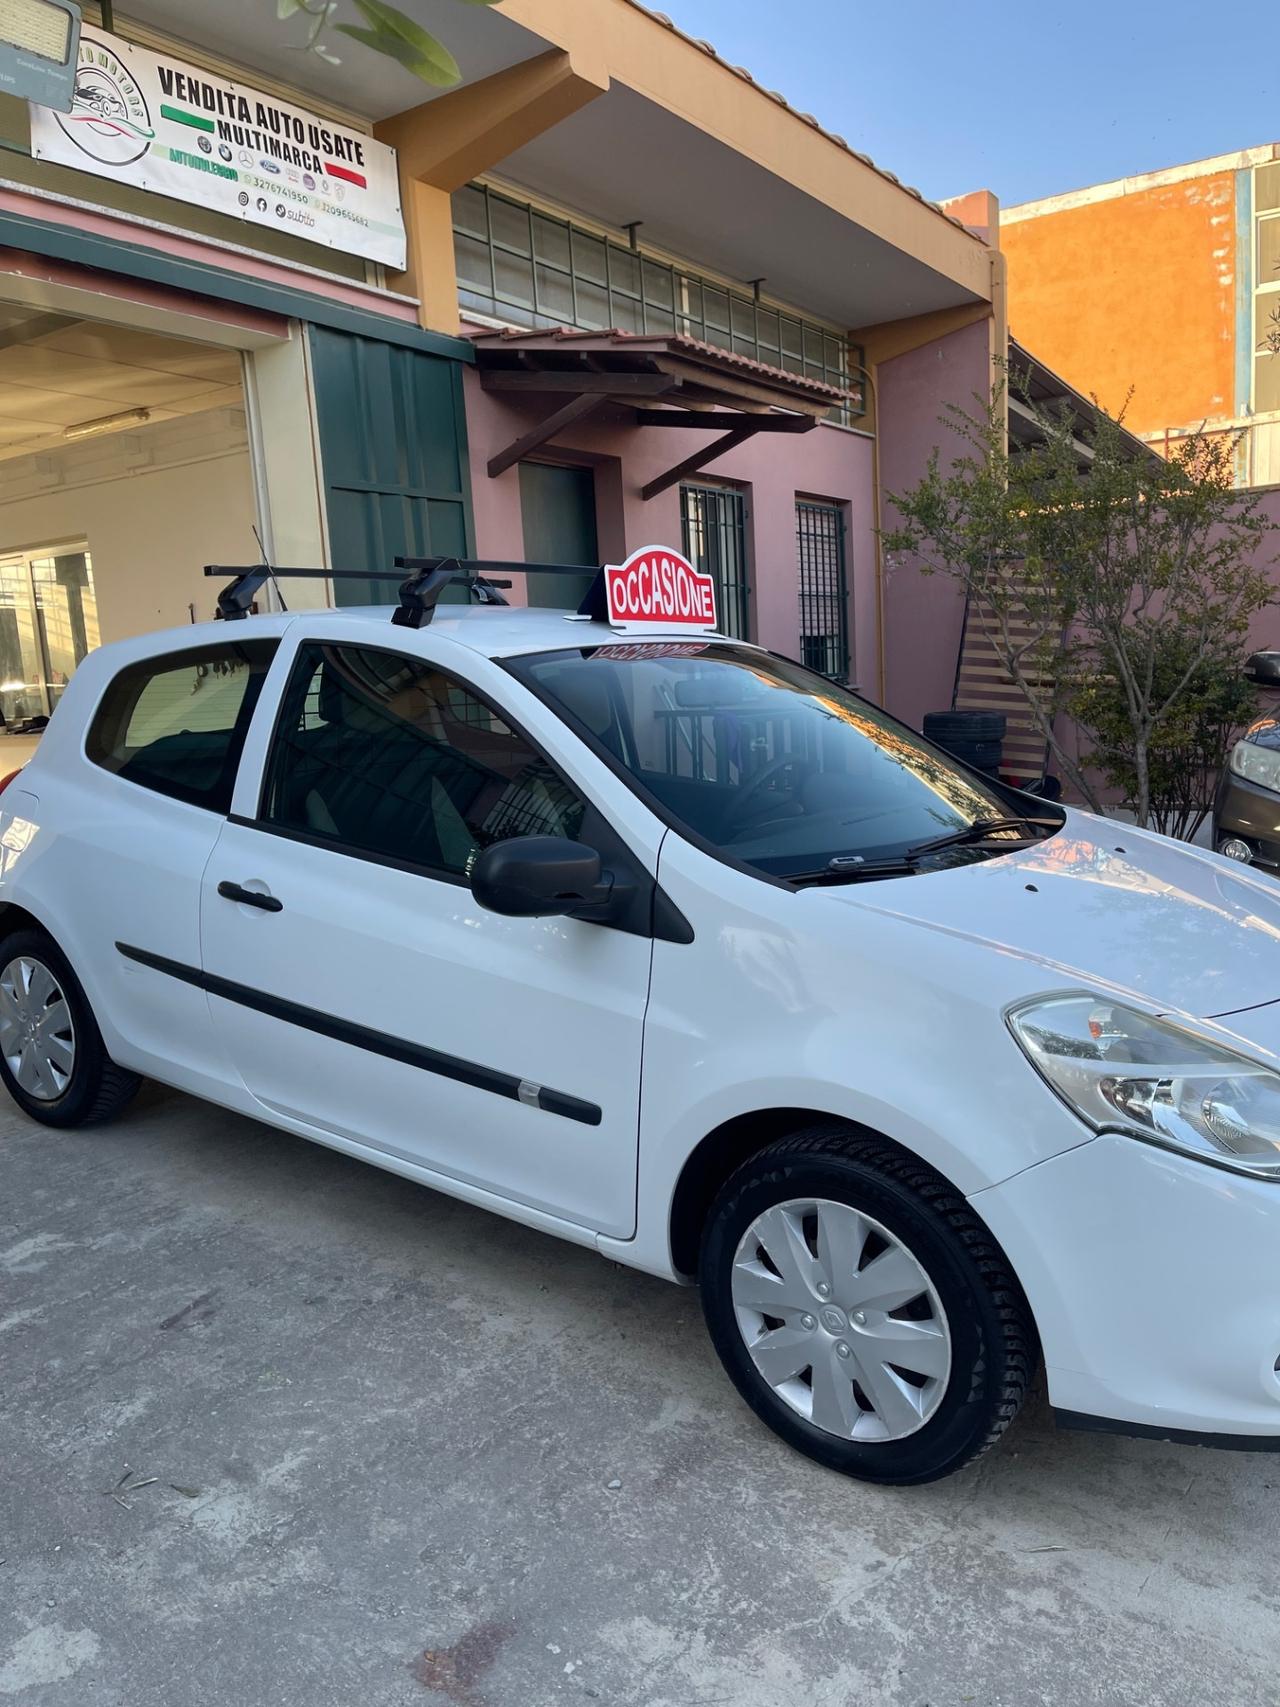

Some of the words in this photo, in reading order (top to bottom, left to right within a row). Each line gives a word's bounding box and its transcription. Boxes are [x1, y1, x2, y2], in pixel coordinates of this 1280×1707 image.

[157, 66, 252, 125] VENDITA
[256, 102, 304, 145] AUTO
[308, 124, 365, 167] USATE
[216, 119, 323, 175] MULTIMARCA
[253, 177, 309, 204] 3276741950
[286, 208, 315, 228] subito
[613, 558, 713, 618] OCCASIONE
